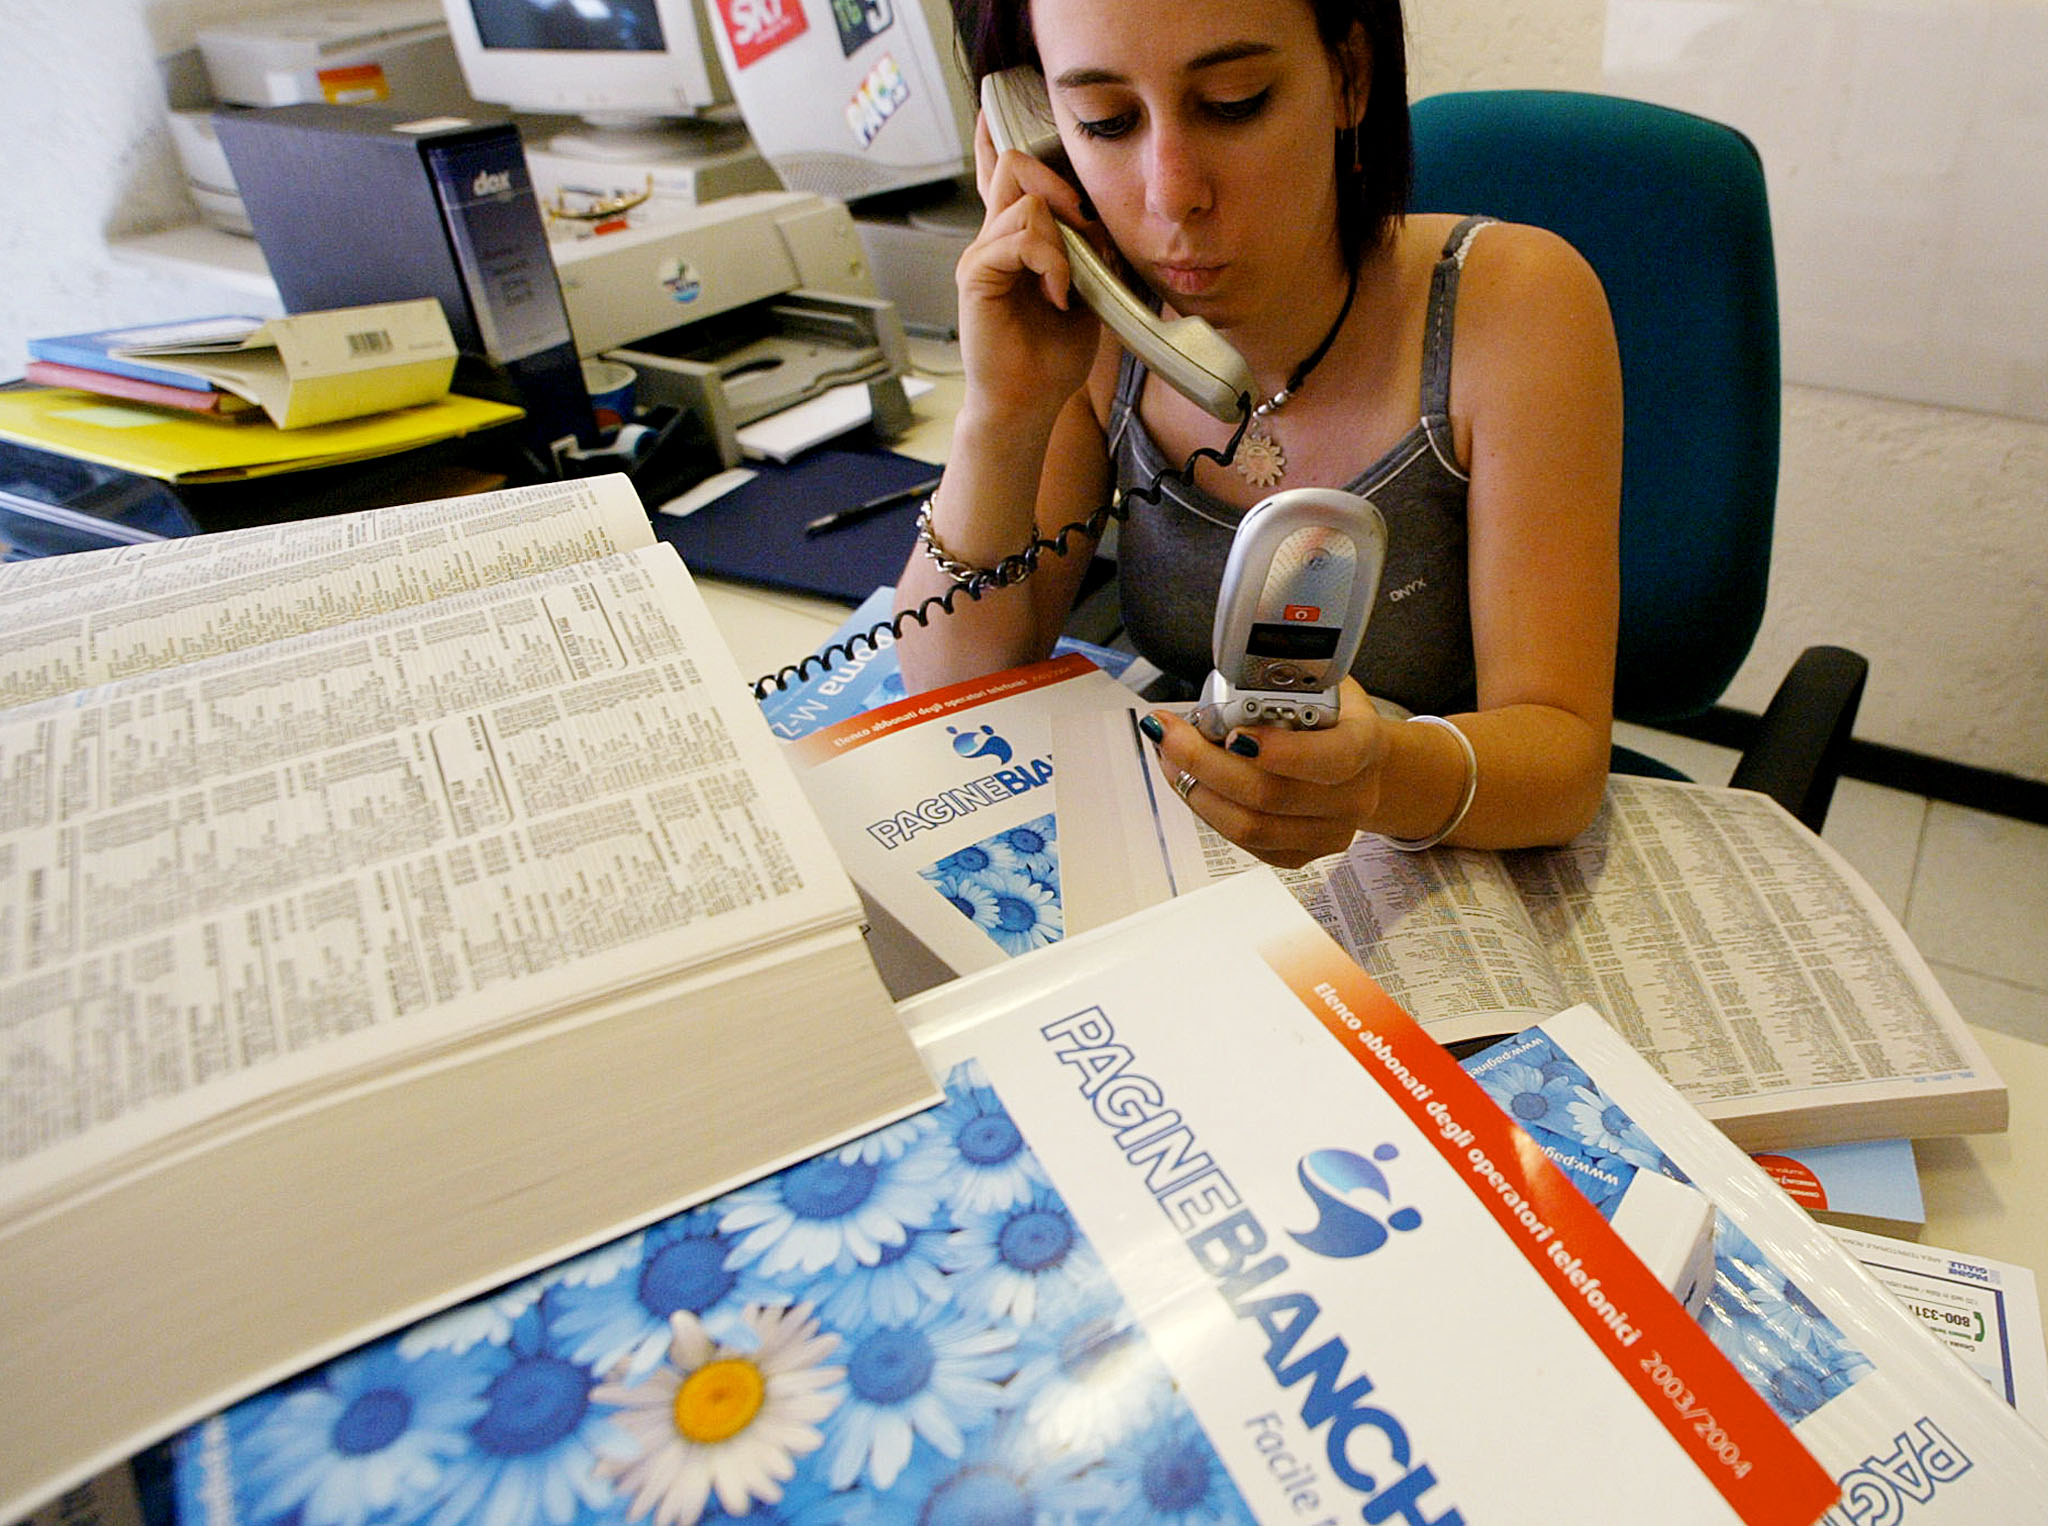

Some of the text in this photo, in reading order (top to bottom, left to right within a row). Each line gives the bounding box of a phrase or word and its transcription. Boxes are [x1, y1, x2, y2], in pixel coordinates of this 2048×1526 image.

[872, 710, 918, 733] abbonati
[917, 702, 943, 719] degli
[866, 754, 1055, 850] PAGINEBIA
[1539, 1145, 1619, 1186] www.pag
[1313, 981, 1362, 1031] Elenco
[1358, 1030, 1433, 1101] abbonati
[1425, 1101, 1475, 1148] degli
[1467, 1148, 1554, 1243] operatori
[1546, 1240, 1643, 1347] telefonici
[1640, 1350, 1753, 1480] 2003/2004
[1246, 1411, 1322, 1515] Facile
[1821, 1416, 1974, 1526] PAG
